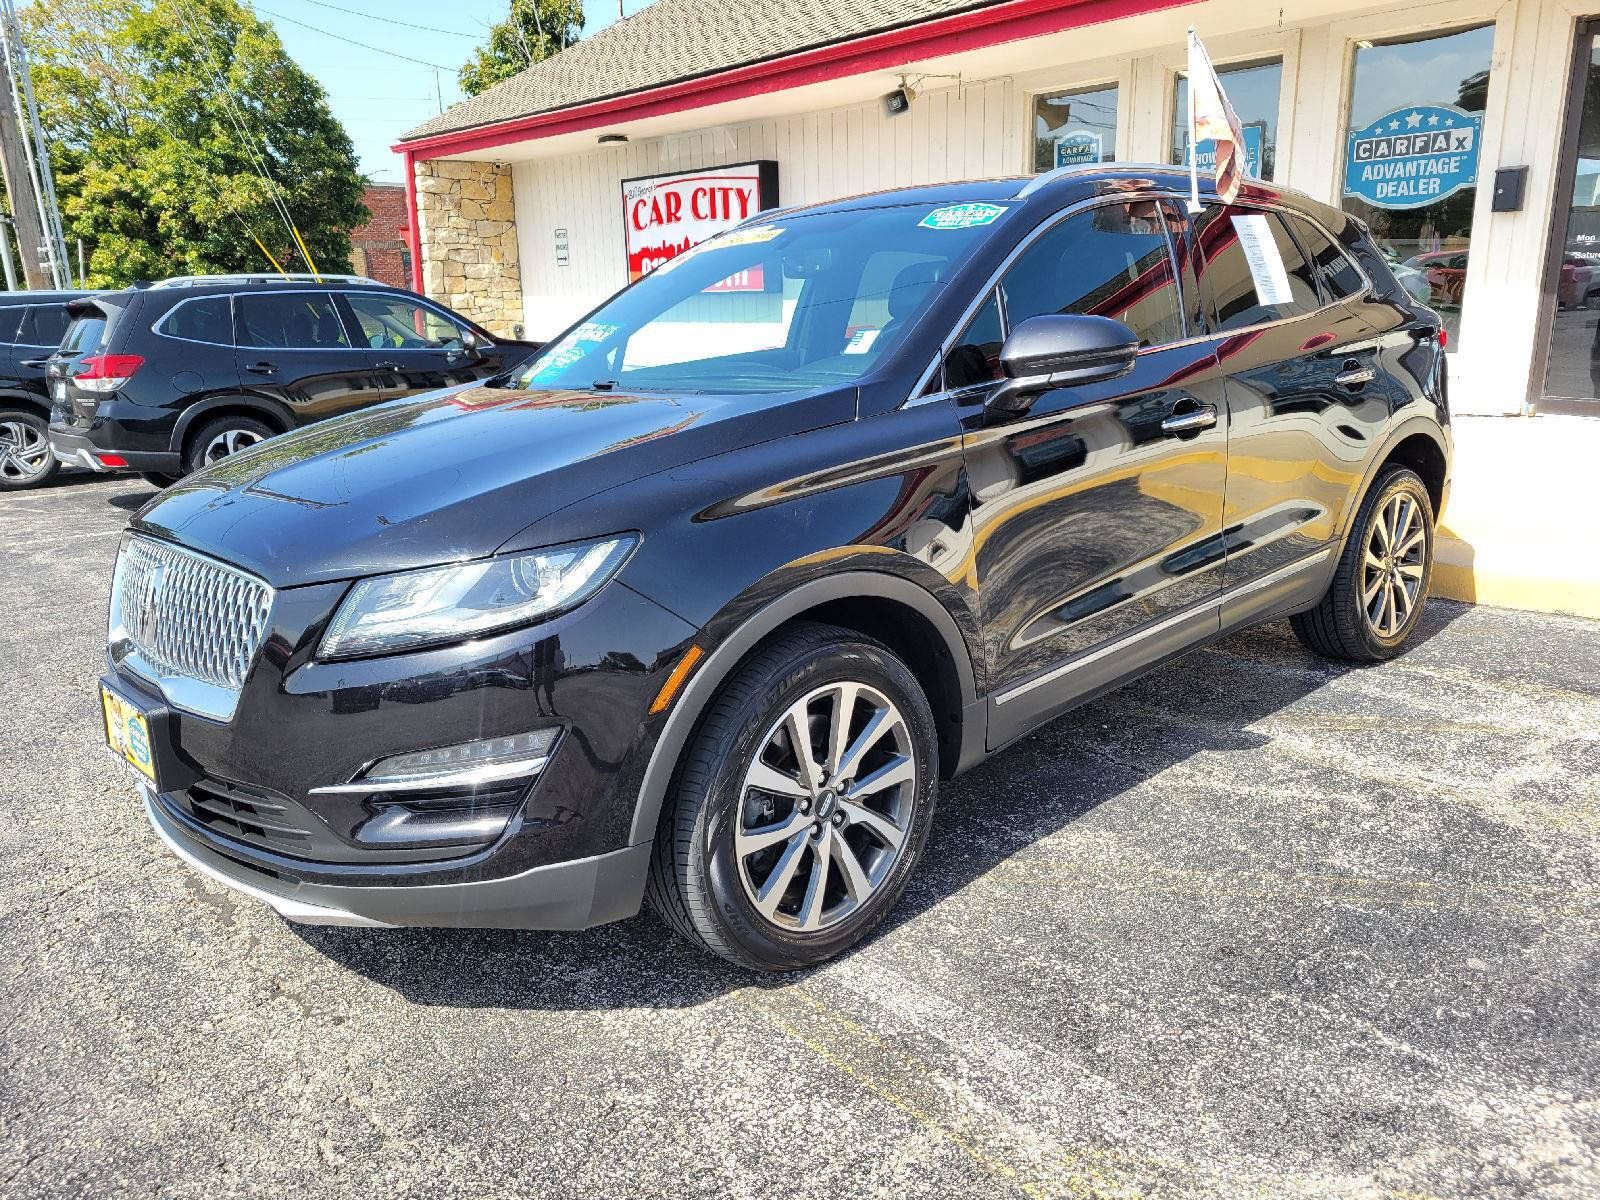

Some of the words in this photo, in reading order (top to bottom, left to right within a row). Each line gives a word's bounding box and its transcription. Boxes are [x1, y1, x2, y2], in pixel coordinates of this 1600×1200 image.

[1060, 143, 1097, 155] CARFAX
[1357, 132, 1472, 160] CARFAX
[1361, 157, 1460, 181] ADVANTAGE
[1376, 177, 1441, 198] DEALER
[632, 191, 682, 232] CAR
[691, 186, 752, 222] CITY
[1576, 234, 1596, 242] Mon
